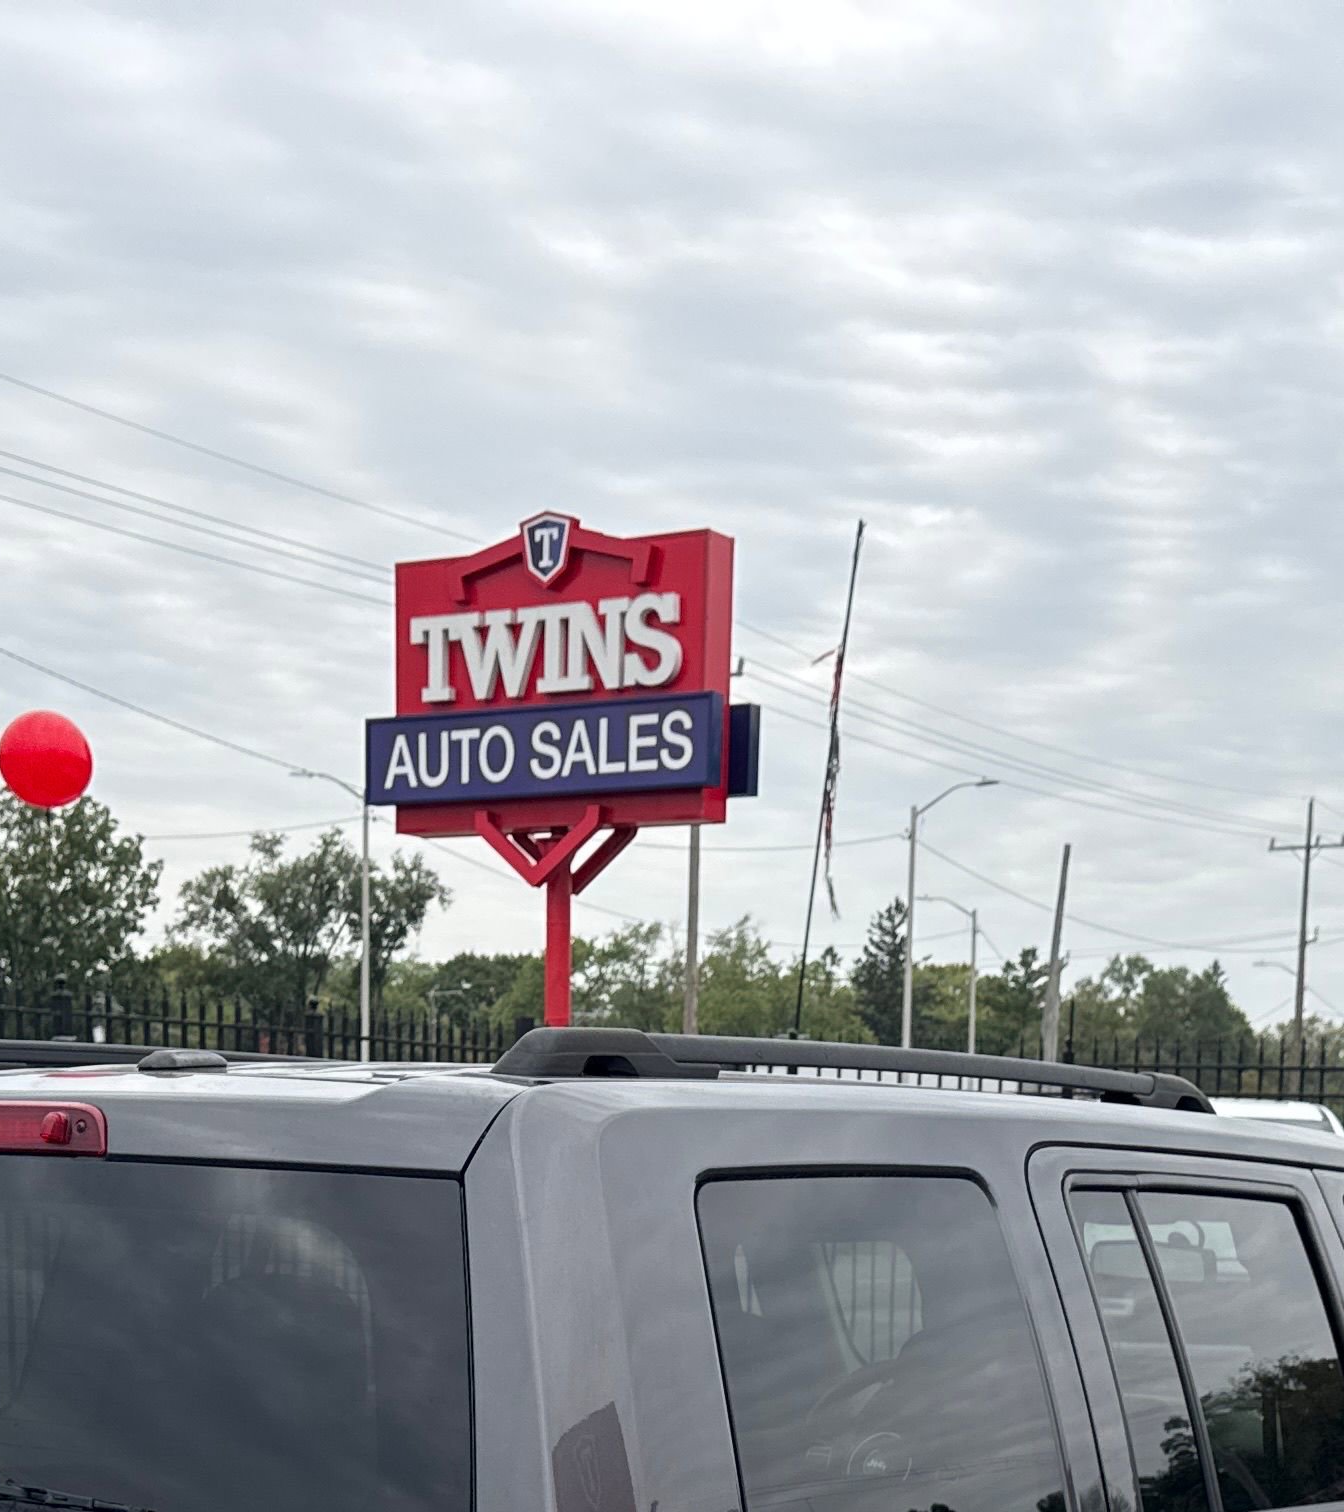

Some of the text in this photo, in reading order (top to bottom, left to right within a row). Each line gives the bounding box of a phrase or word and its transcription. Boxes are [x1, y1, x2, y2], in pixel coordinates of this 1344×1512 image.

[532, 527, 560, 568] T
[409, 592, 684, 704] TWINS
[384, 710, 694, 790] AUTO SALES
